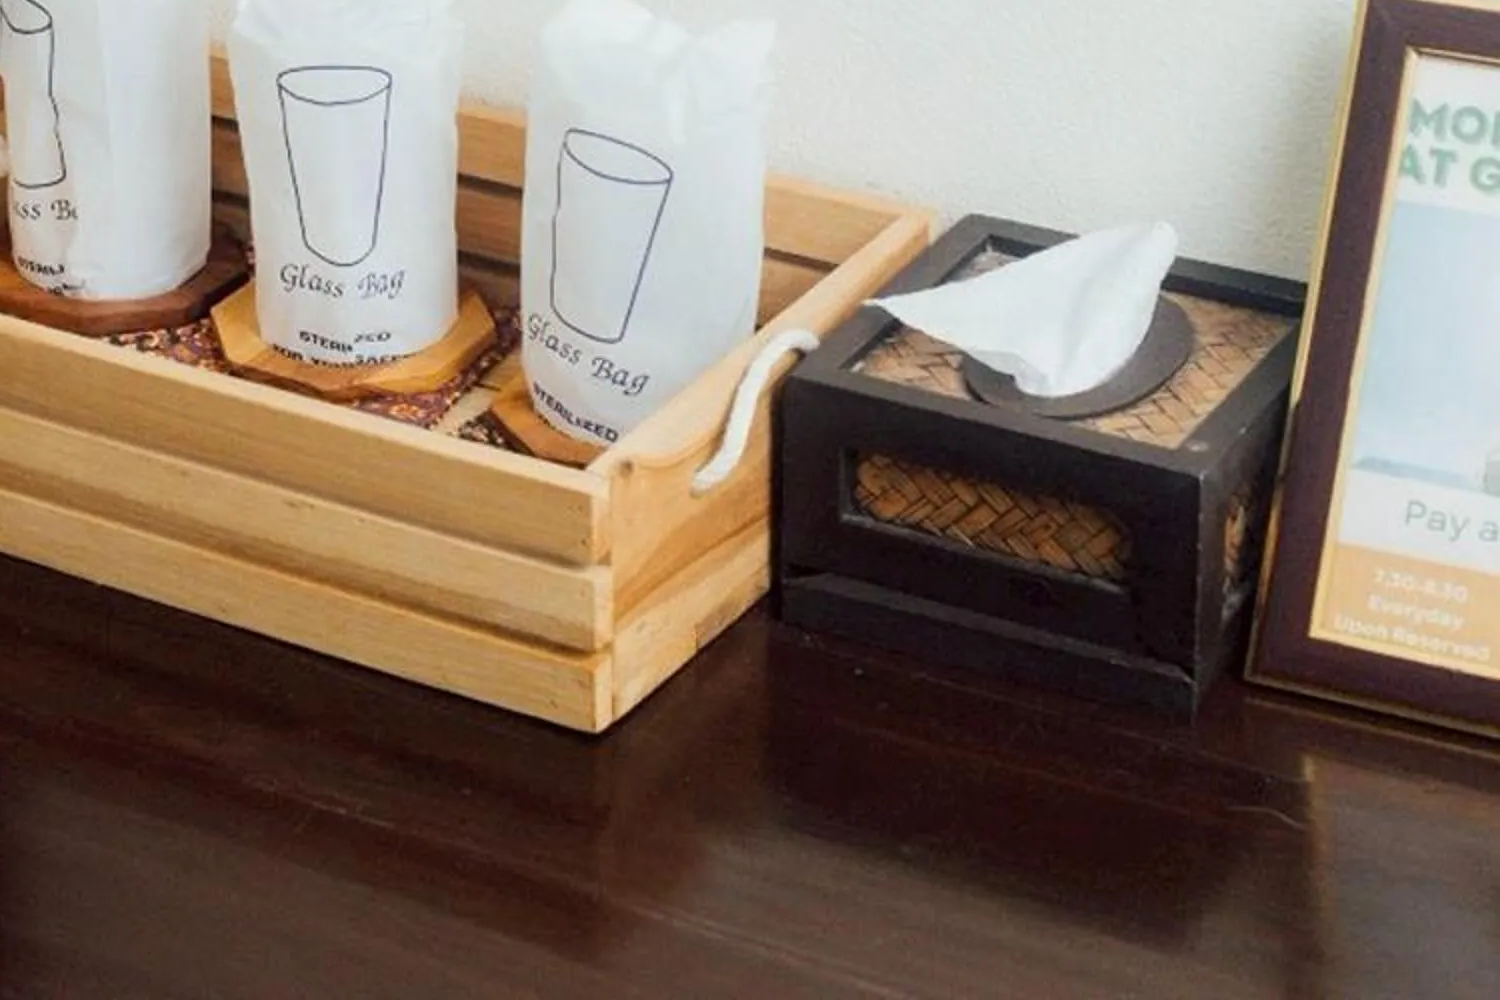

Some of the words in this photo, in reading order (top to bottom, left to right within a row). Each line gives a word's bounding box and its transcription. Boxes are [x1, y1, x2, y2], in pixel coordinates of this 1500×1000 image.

[1400, 145, 1458, 188] AT
[280, 263, 345, 298] Glass
[357, 269, 406, 299] Bag
[528, 313, 582, 365] Glass
[592, 356, 650, 396] Bag
[1405, 499, 1470, 543] Pay
[1368, 593, 1464, 632] Everyday
[1334, 613, 1389, 638] Upon
[1393, 627, 1490, 661] Reserved
